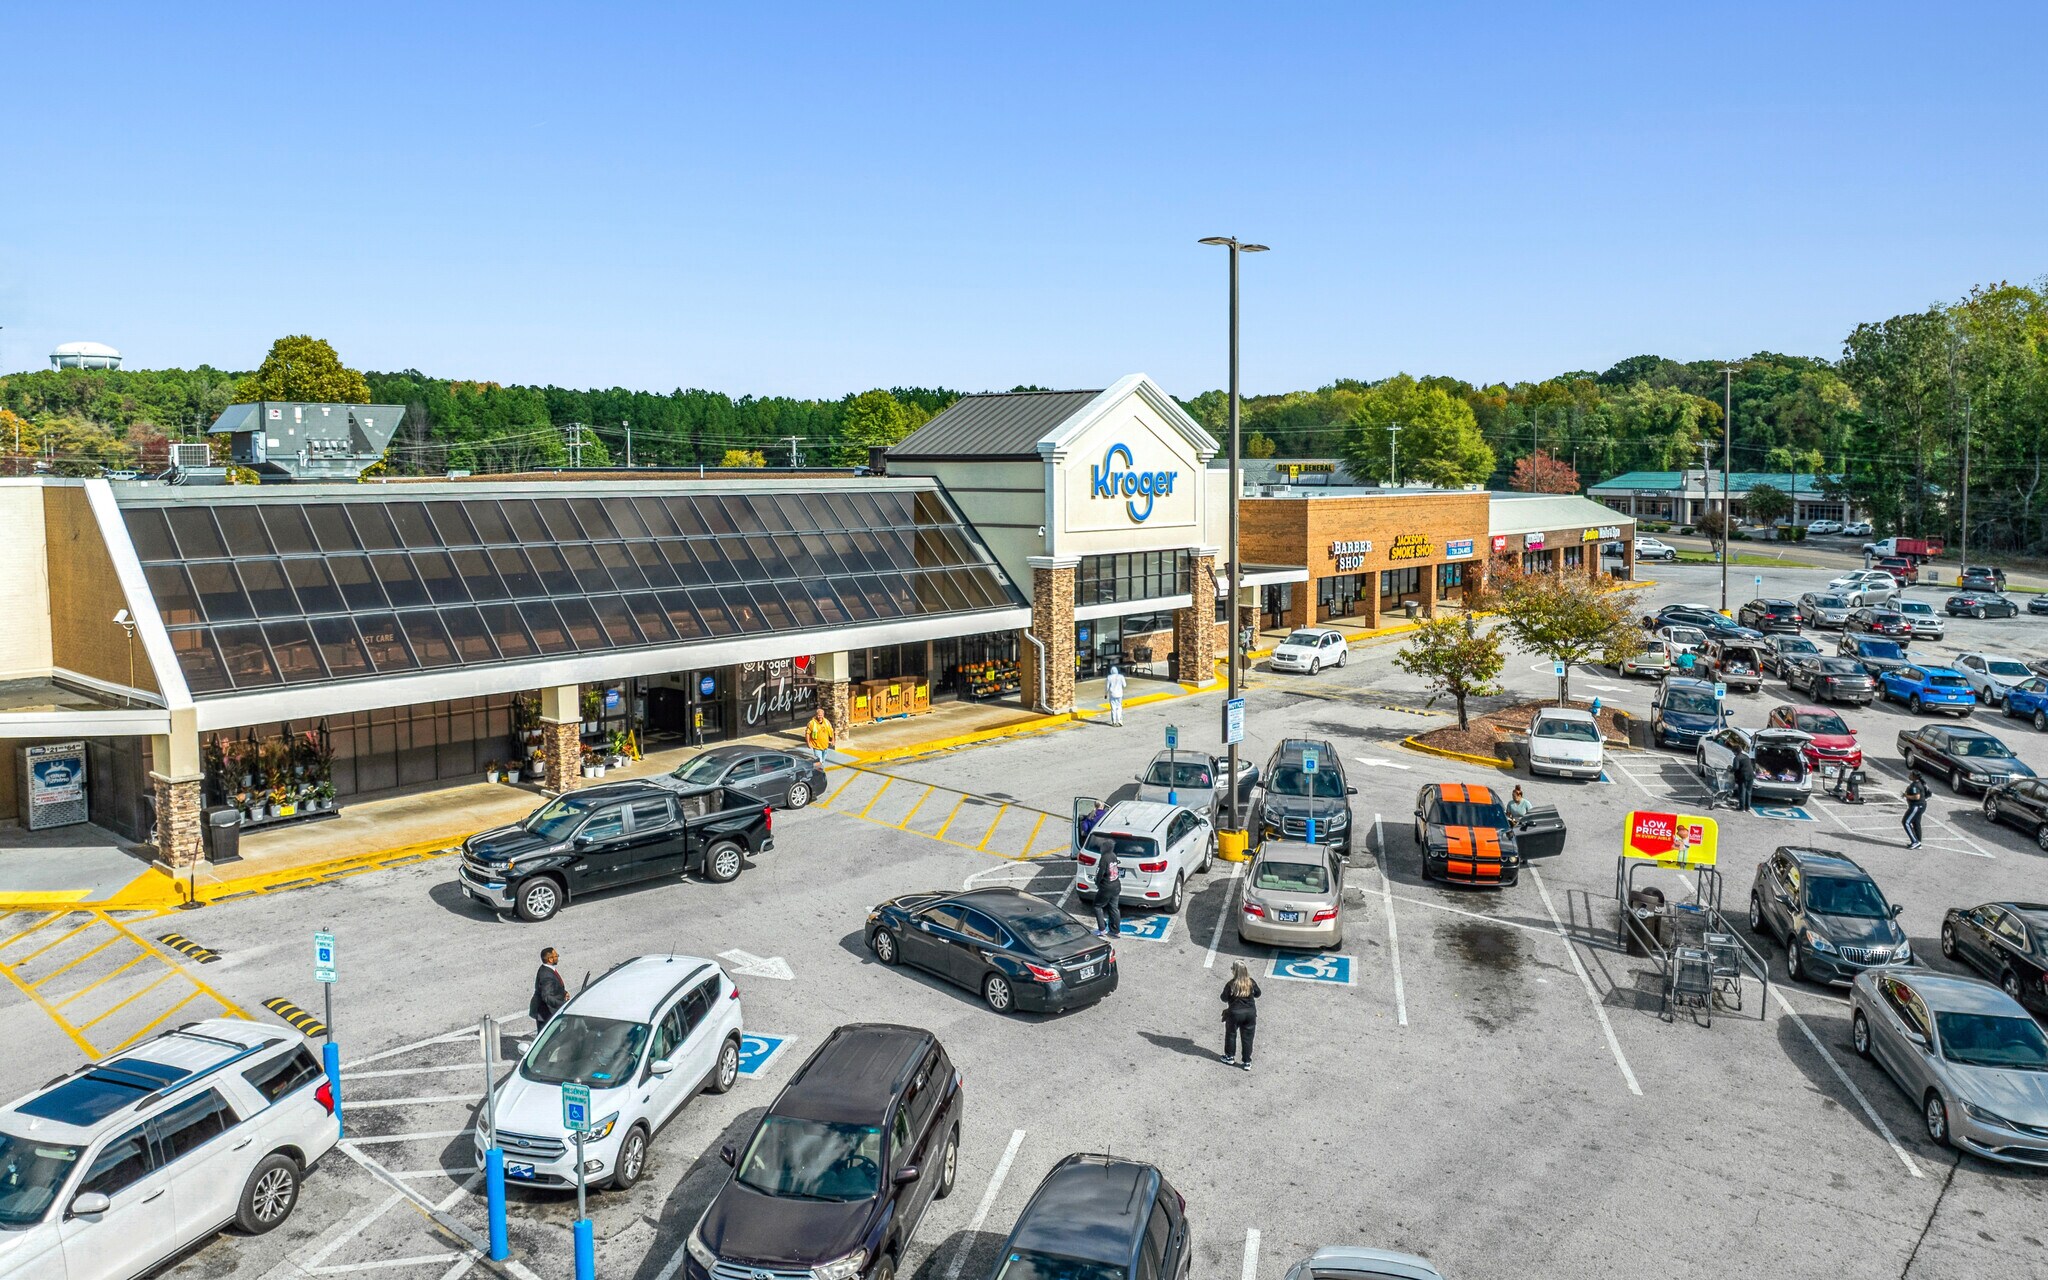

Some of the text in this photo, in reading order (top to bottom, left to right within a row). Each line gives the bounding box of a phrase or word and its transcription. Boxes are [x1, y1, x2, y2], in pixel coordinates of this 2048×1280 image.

[1094, 443, 1178, 521] Kroger
[1397, 534, 1428, 546] JACKSON'S
[1333, 540, 1373, 555] BARBER
[1391, 546, 1415, 560] SMOKE
[1415, 544, 1435, 557] SHOP
[1339, 556, 1365, 570] SHOP
[376, 633, 394, 643] CARE
[1643, 820, 1667, 829] LOW
[1636, 827, 1672, 836] PRICES
[564, 1087, 589, 1096] RESERVED
